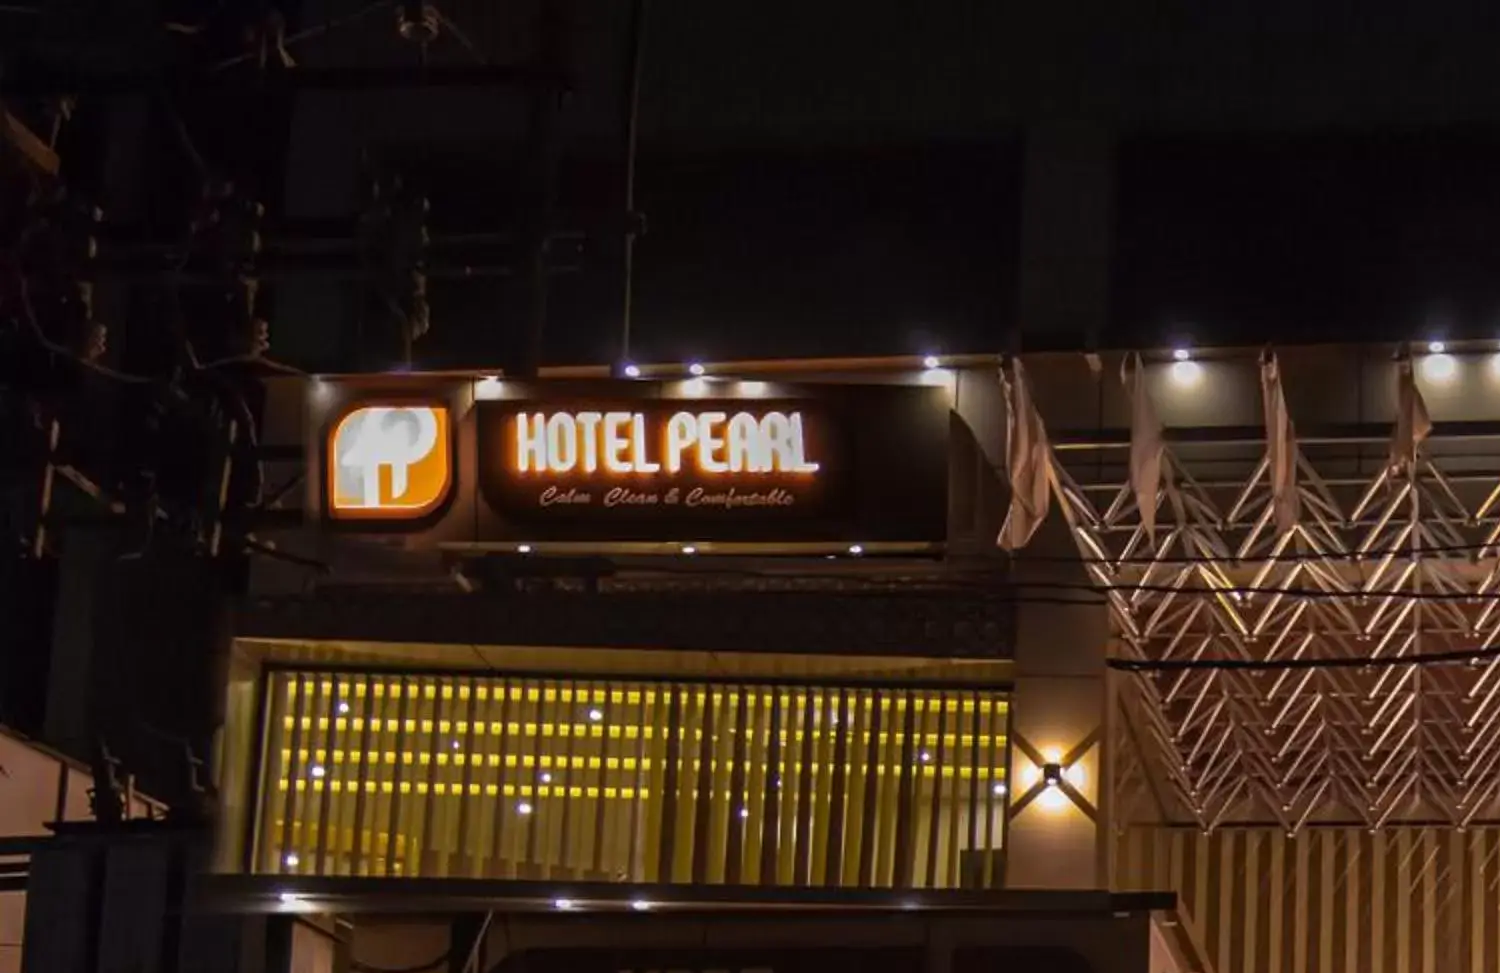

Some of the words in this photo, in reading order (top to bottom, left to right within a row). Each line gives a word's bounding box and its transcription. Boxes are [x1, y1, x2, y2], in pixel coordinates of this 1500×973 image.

[515, 410, 660, 474] HOTEL
[666, 410, 820, 474] PEARL
[539, 485, 592, 507] Calm
[603, 485, 658, 507] Clean
[663, 486, 680, 505] &
[685, 485, 796, 508] Comfortable
